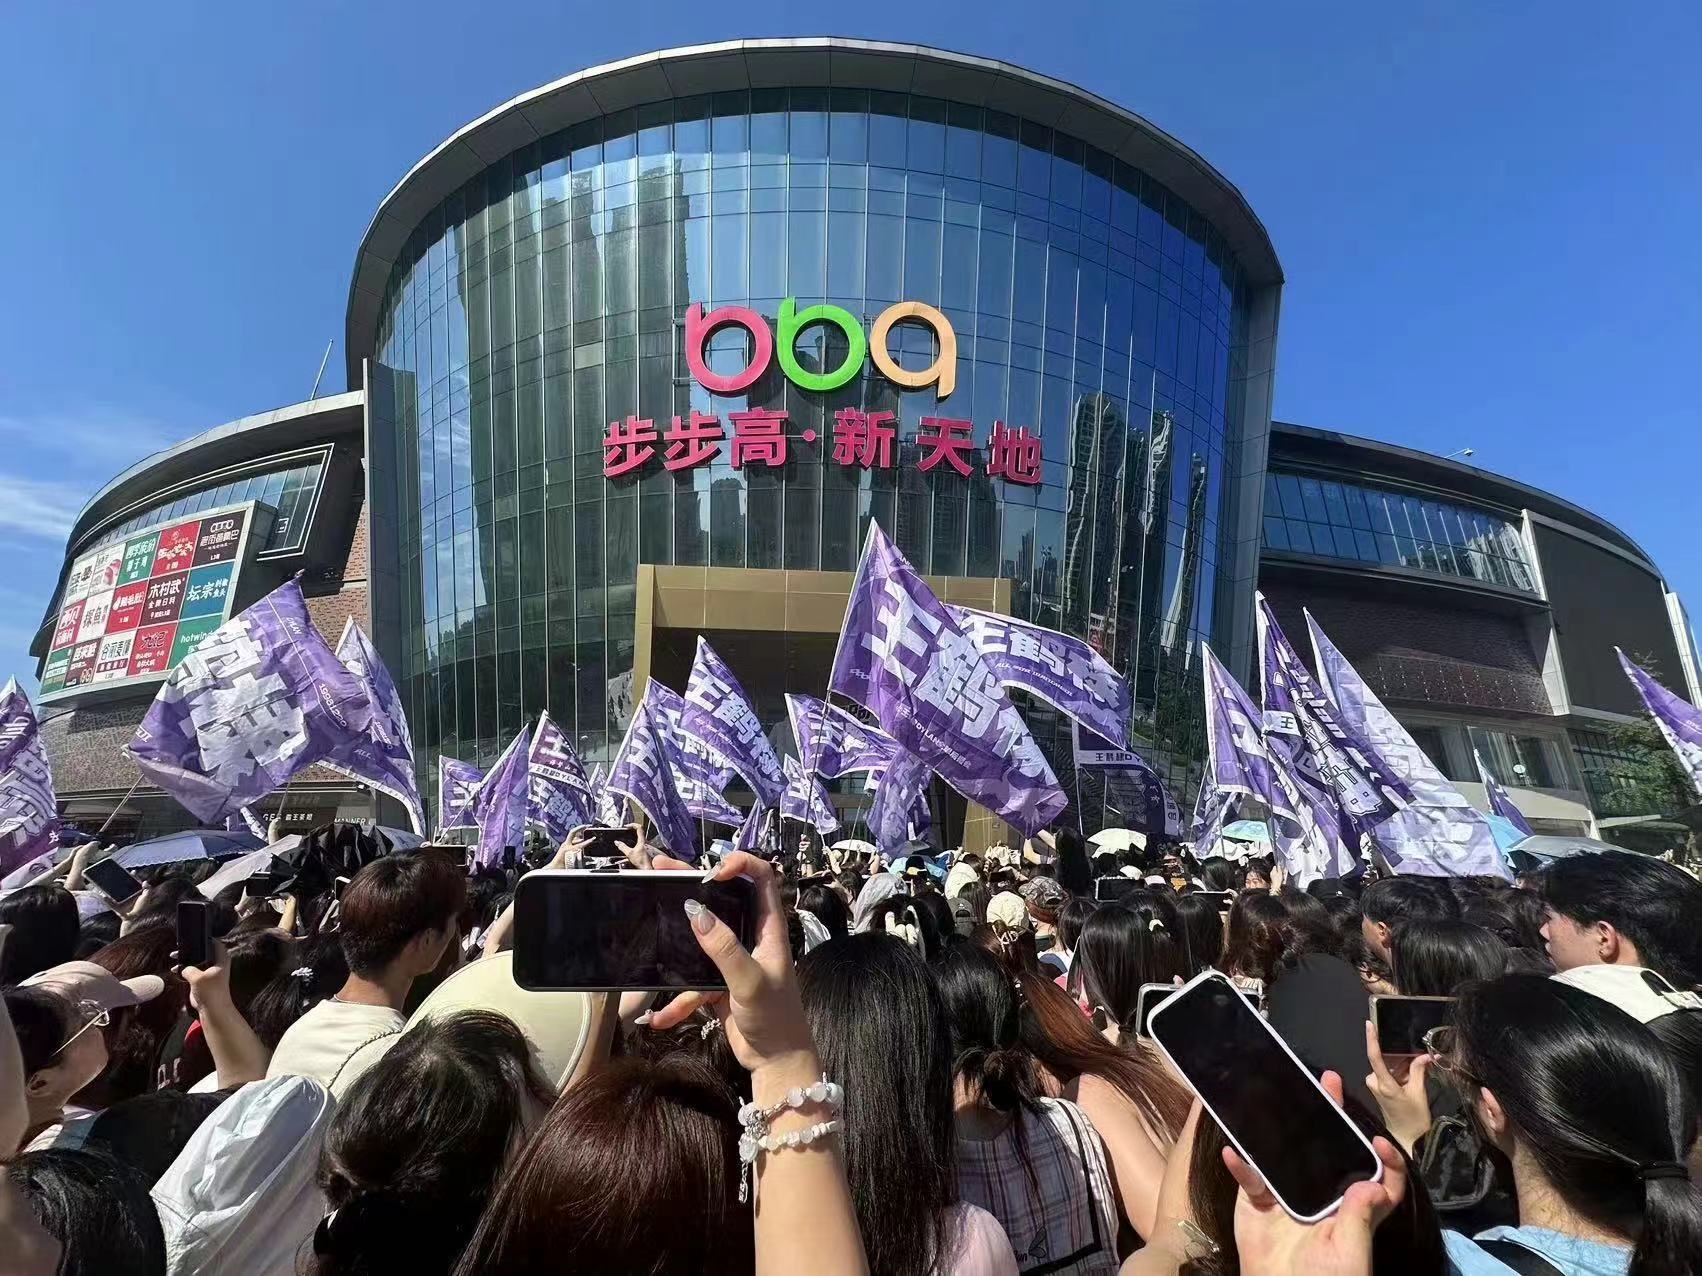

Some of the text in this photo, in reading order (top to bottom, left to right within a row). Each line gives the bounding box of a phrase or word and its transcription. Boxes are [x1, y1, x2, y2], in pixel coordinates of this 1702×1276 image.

[148, 579, 182, 599] 木村武
[186, 581, 214, 601] 坛宗
[317, 682, 349, 728] 19981220
